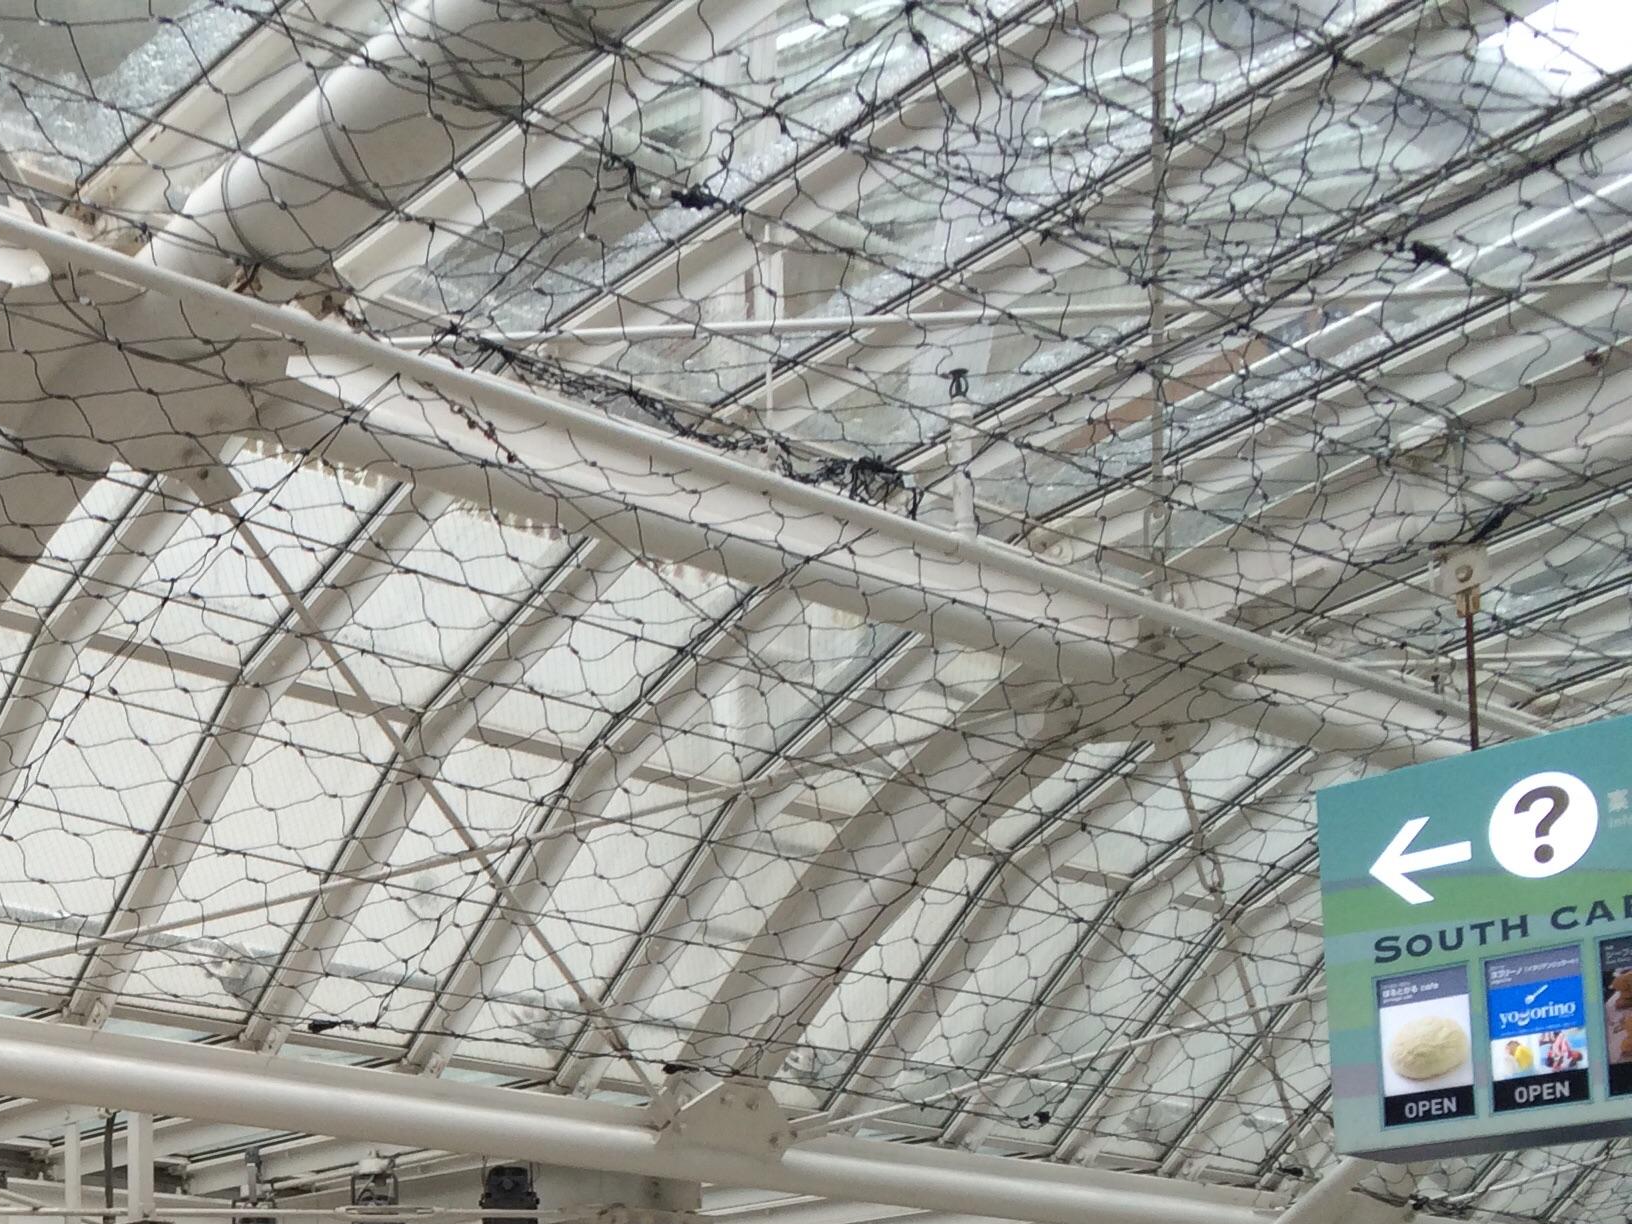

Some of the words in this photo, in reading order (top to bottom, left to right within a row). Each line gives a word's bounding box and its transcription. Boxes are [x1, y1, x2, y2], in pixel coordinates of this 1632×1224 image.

[1374, 914, 1530, 964] SOUTH
[1499, 1001, 1576, 1029] yogorino
[1514, 1080, 1570, 1104] OPEN
[1404, 1096, 1457, 1119] OPEN
